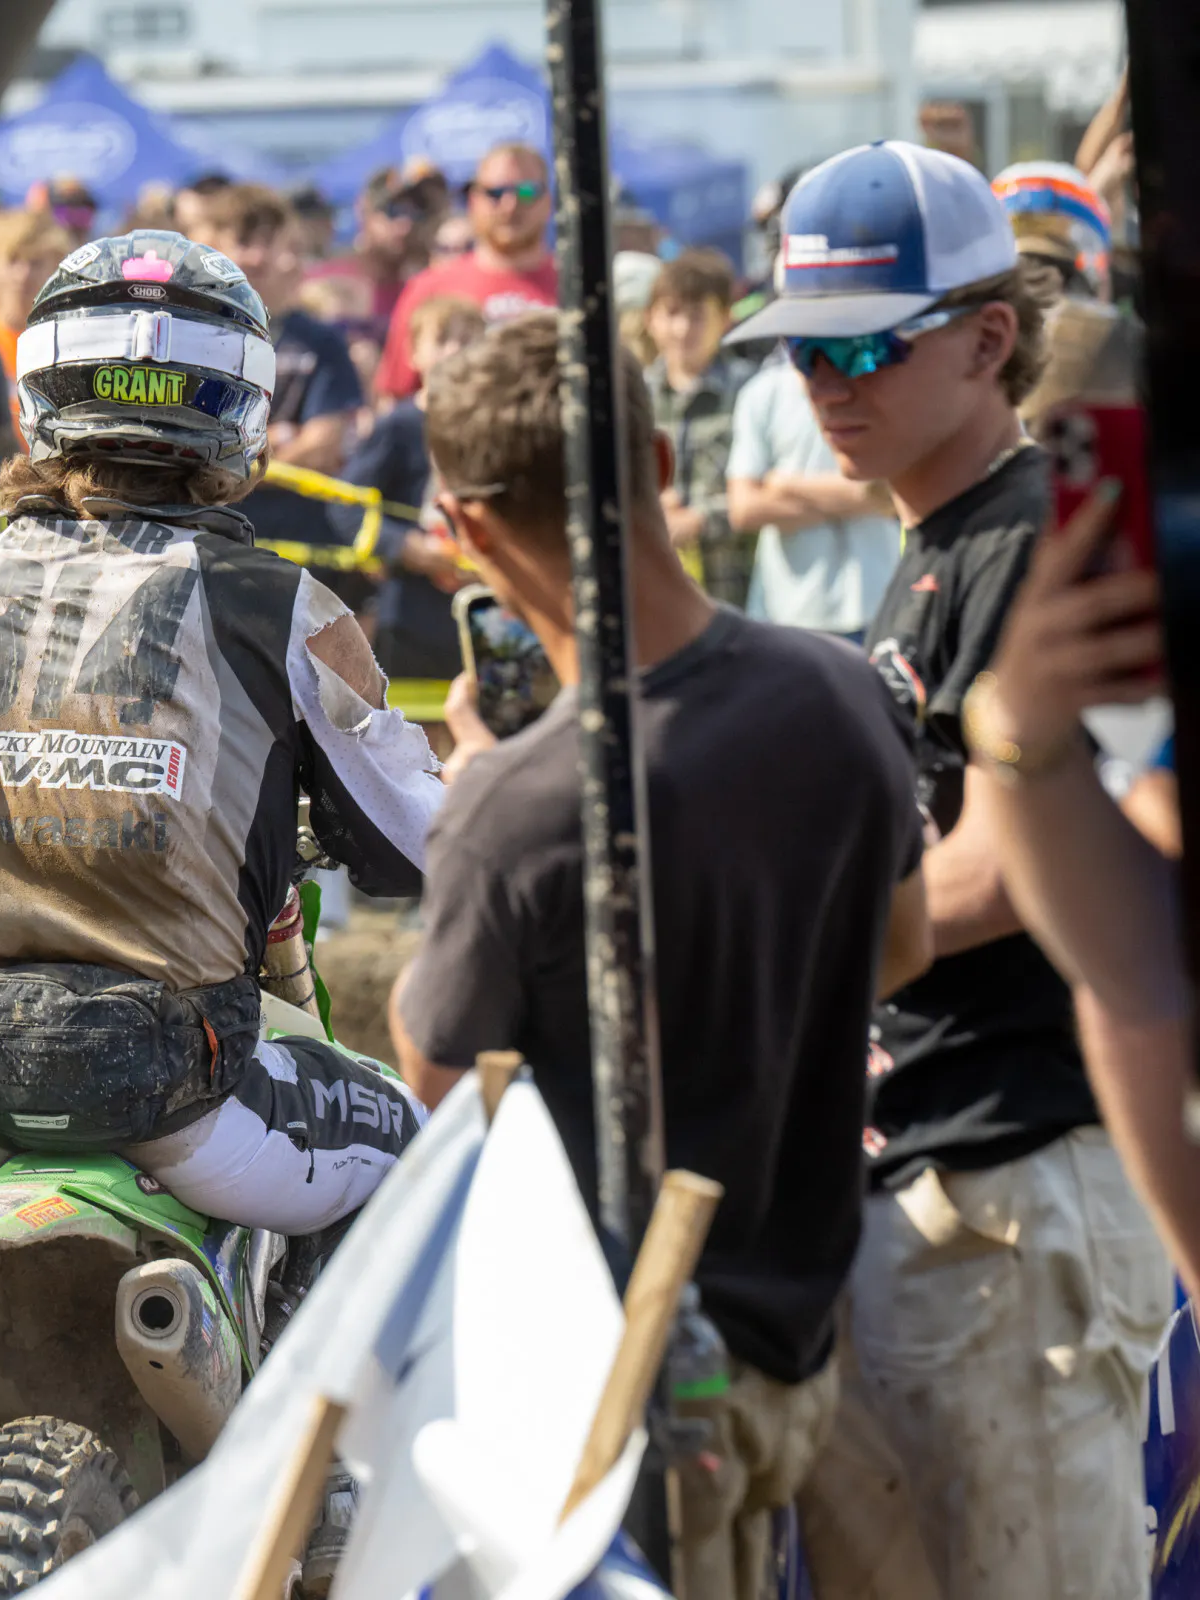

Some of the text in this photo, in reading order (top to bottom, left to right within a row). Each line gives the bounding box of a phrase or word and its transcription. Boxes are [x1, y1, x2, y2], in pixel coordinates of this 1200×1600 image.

[132, 286, 162, 298] SHOEI
[94, 365, 187, 407] GRANT
[40, 733, 168, 760] MOUNTAIN
